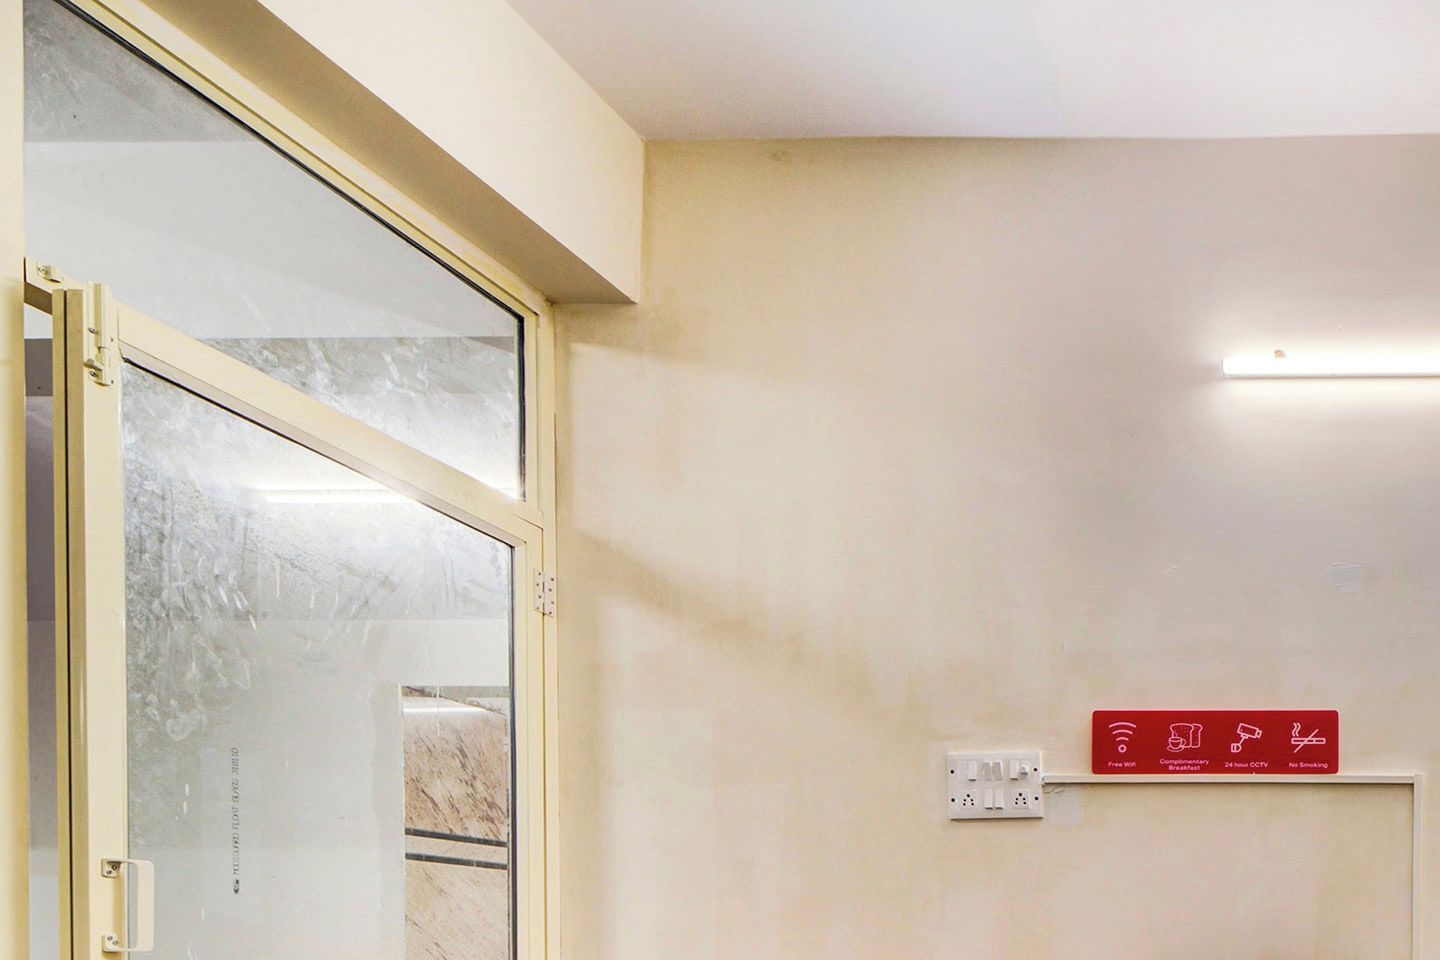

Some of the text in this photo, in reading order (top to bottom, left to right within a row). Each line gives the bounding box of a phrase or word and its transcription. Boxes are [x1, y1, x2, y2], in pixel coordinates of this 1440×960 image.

[1123, 760, 1137, 768] Wifi
[1159, 758, 1209, 766] Complimentary
[1299, 761, 1329, 769] Smoking
